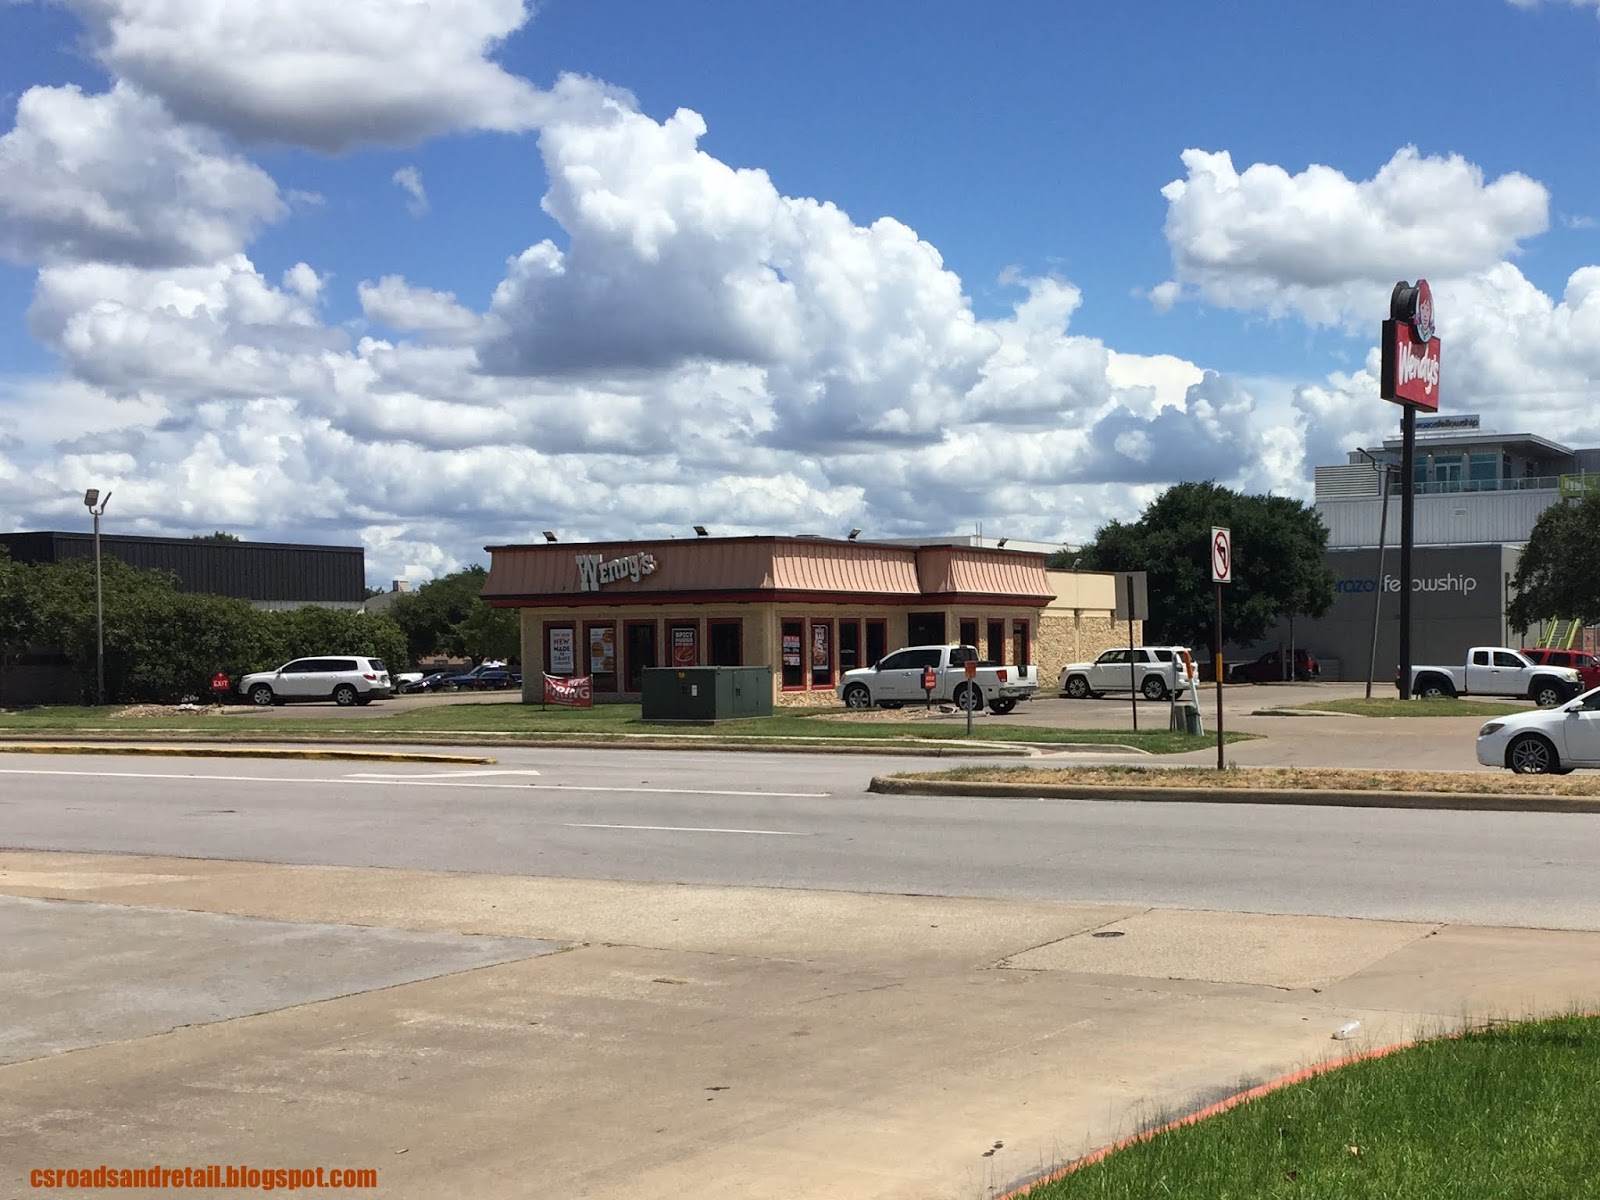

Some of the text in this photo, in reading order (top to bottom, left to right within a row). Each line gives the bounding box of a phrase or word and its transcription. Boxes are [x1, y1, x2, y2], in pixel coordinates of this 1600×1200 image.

[1398, 341, 1439, 395] Wendy's
[575, 552, 657, 591] Wendy's
[1384, 573, 1477, 596] feowship
[545, 682, 590, 699] HIRING
